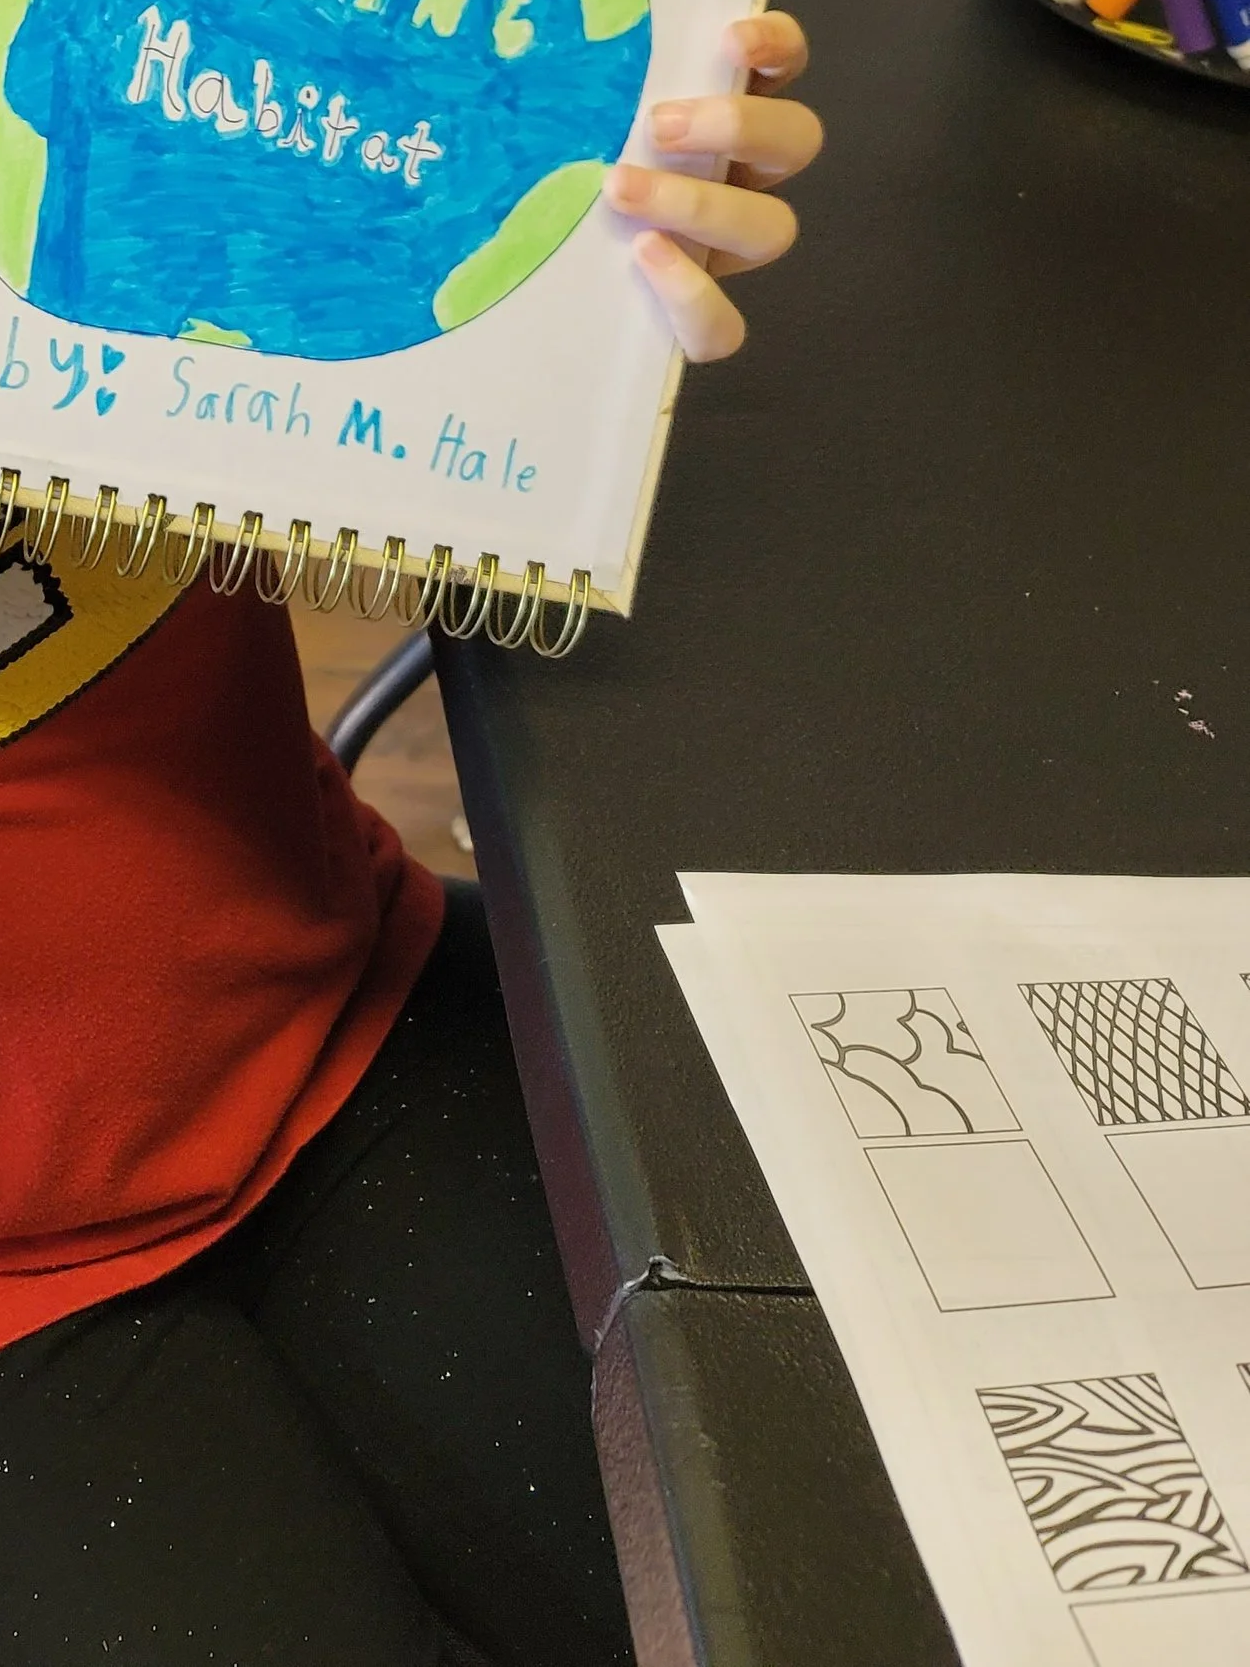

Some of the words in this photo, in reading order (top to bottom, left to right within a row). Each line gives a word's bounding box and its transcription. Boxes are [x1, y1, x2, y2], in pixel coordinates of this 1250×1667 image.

[125, 5, 444, 188] Habitat
[166, 355, 312, 438] Sarah
[337, 399, 407, 460] M.
[430, 413, 539, 494] Hale
